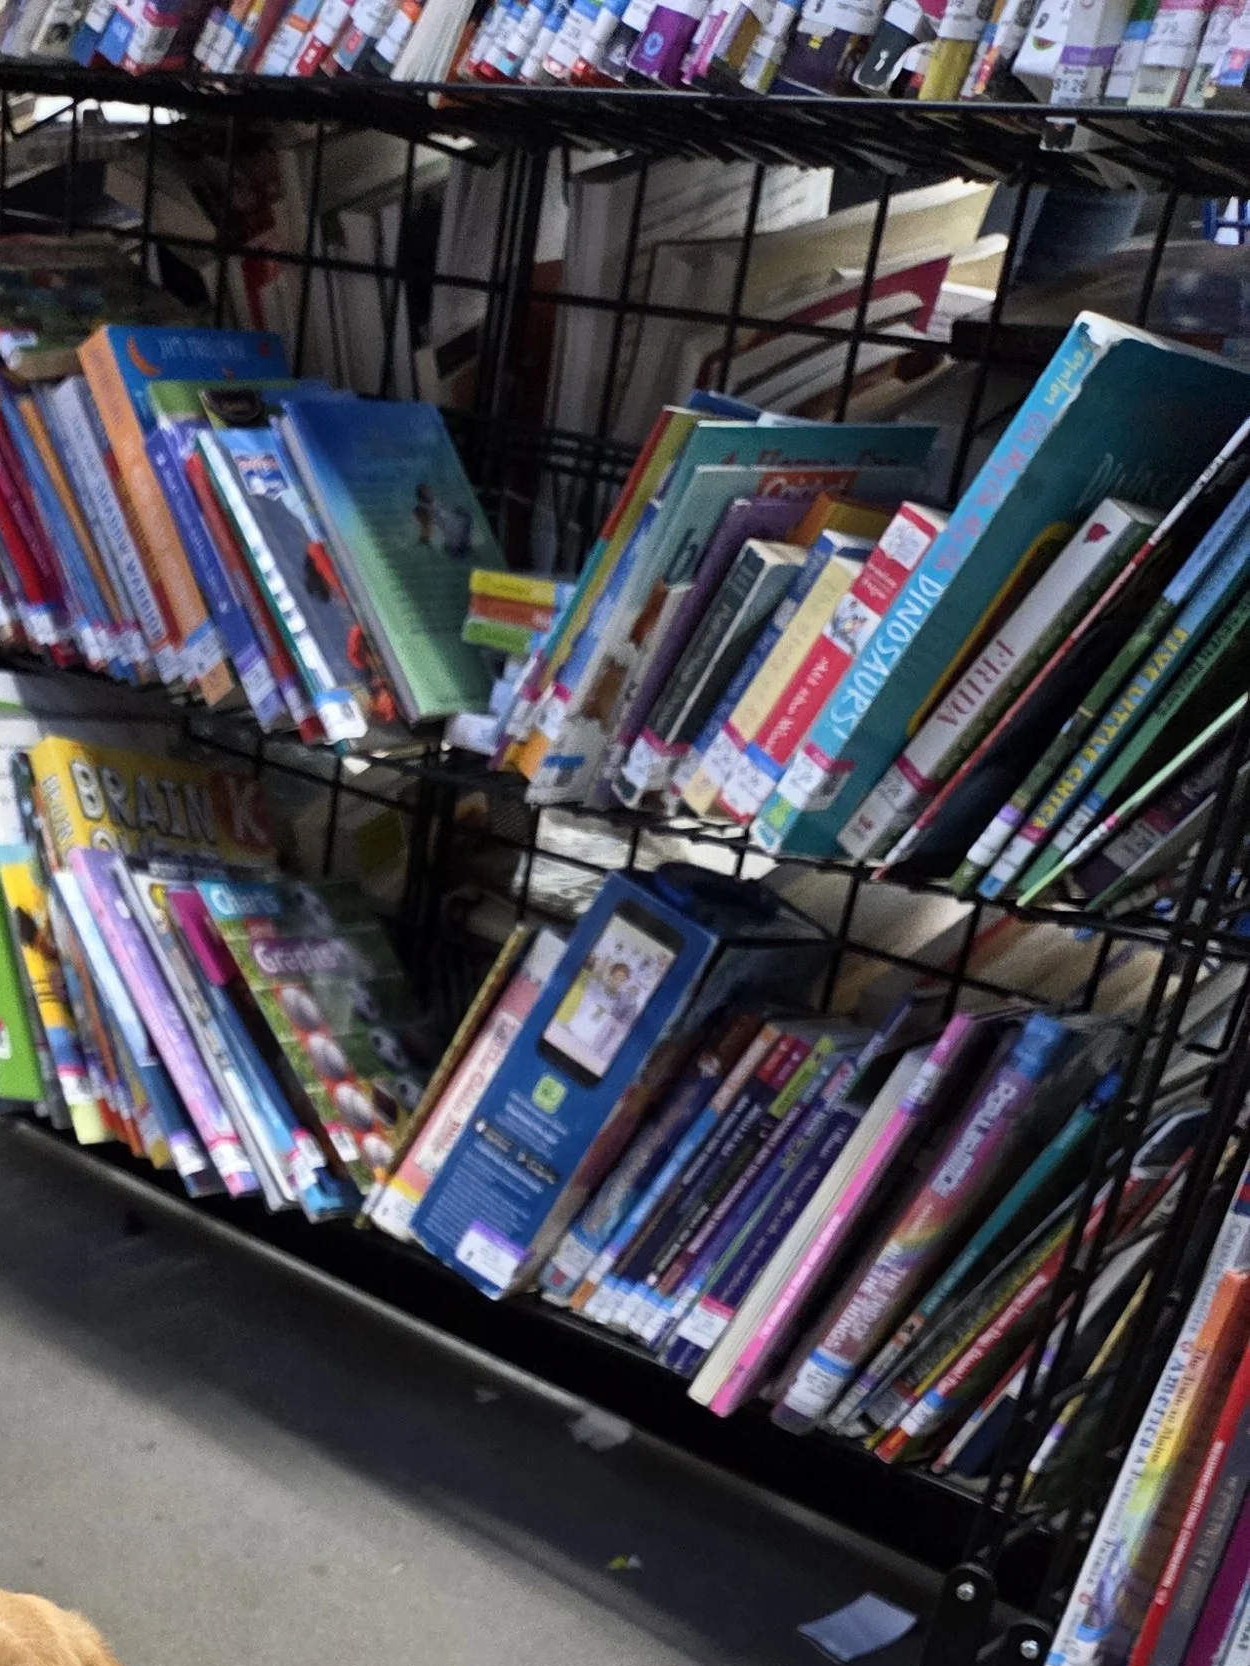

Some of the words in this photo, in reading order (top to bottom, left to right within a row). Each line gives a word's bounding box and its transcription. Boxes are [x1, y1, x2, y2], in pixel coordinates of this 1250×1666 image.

[824, 571, 947, 742] DINOSAURS!
[935, 637, 1017, 726] FRIDA
[69, 758, 217, 847] BRAIN
